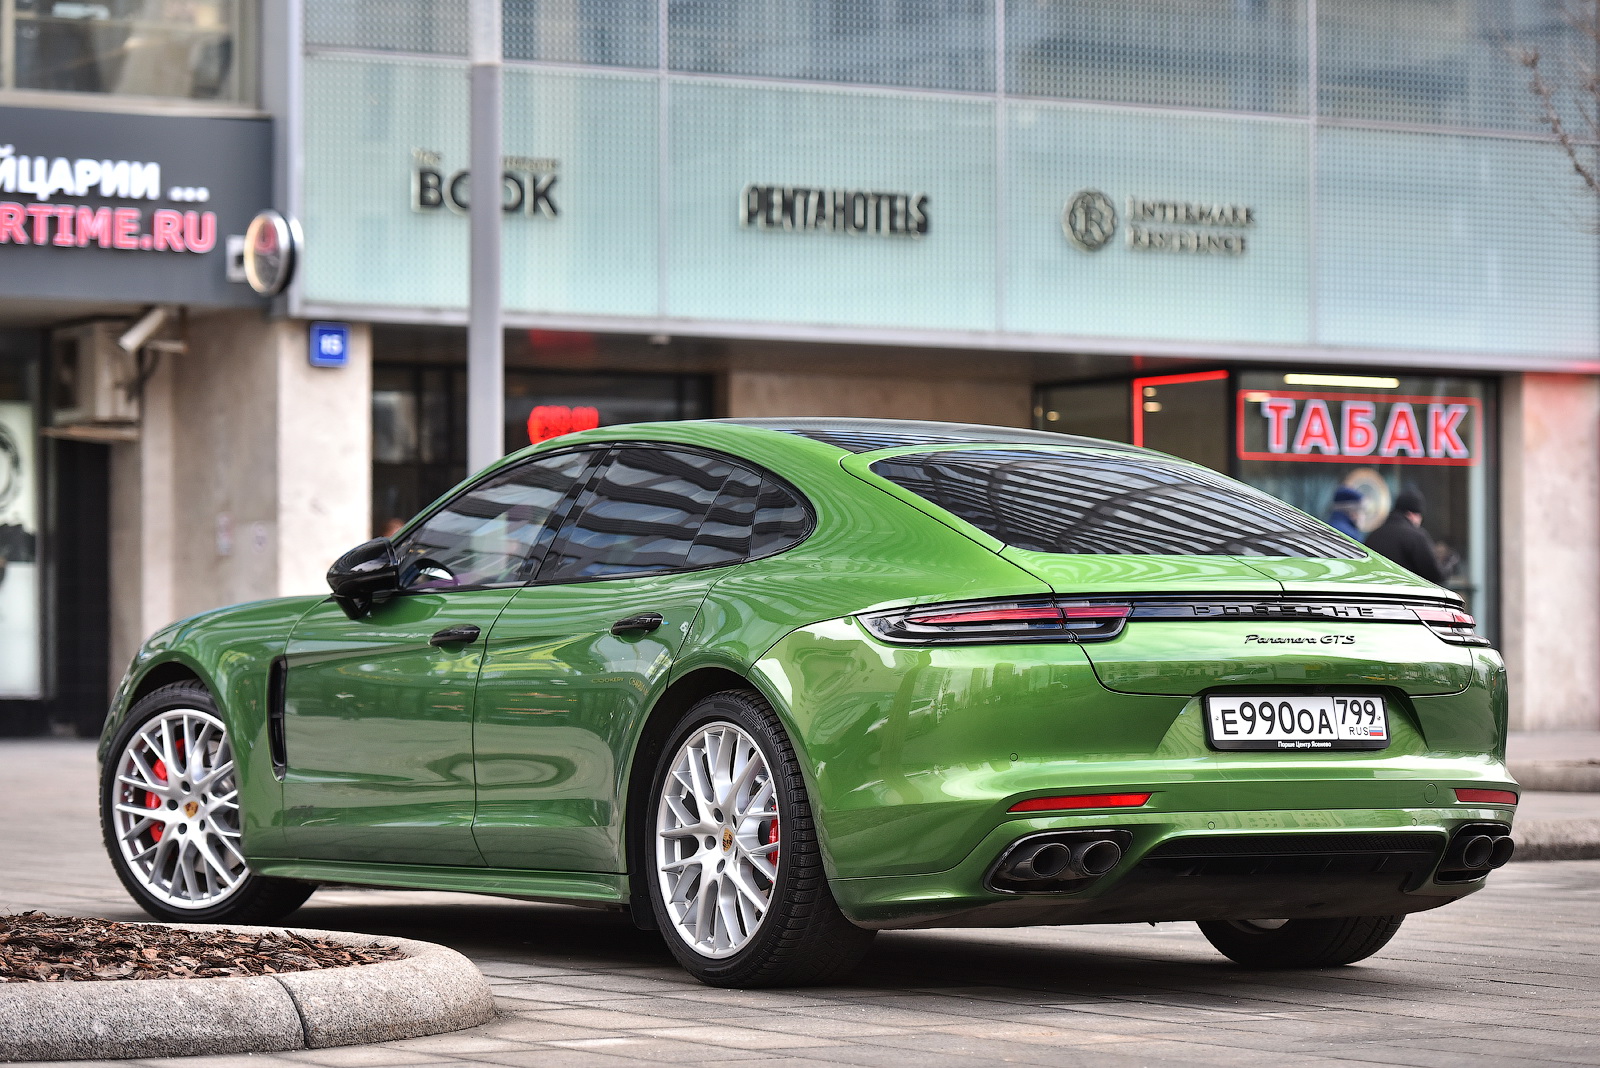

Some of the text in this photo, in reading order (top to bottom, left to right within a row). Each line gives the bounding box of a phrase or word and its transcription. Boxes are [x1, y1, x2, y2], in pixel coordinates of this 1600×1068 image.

[0, 201, 217, 253] RTIME.RU
[1261, 397, 1470, 458] ТАБАК
[1193, 603, 1374, 618] PORSCHE
[1244, 634, 1356, 645] Panamera GTS
[1335, 699, 1376, 725] 799
[1348, 726, 1369, 736] RUS
